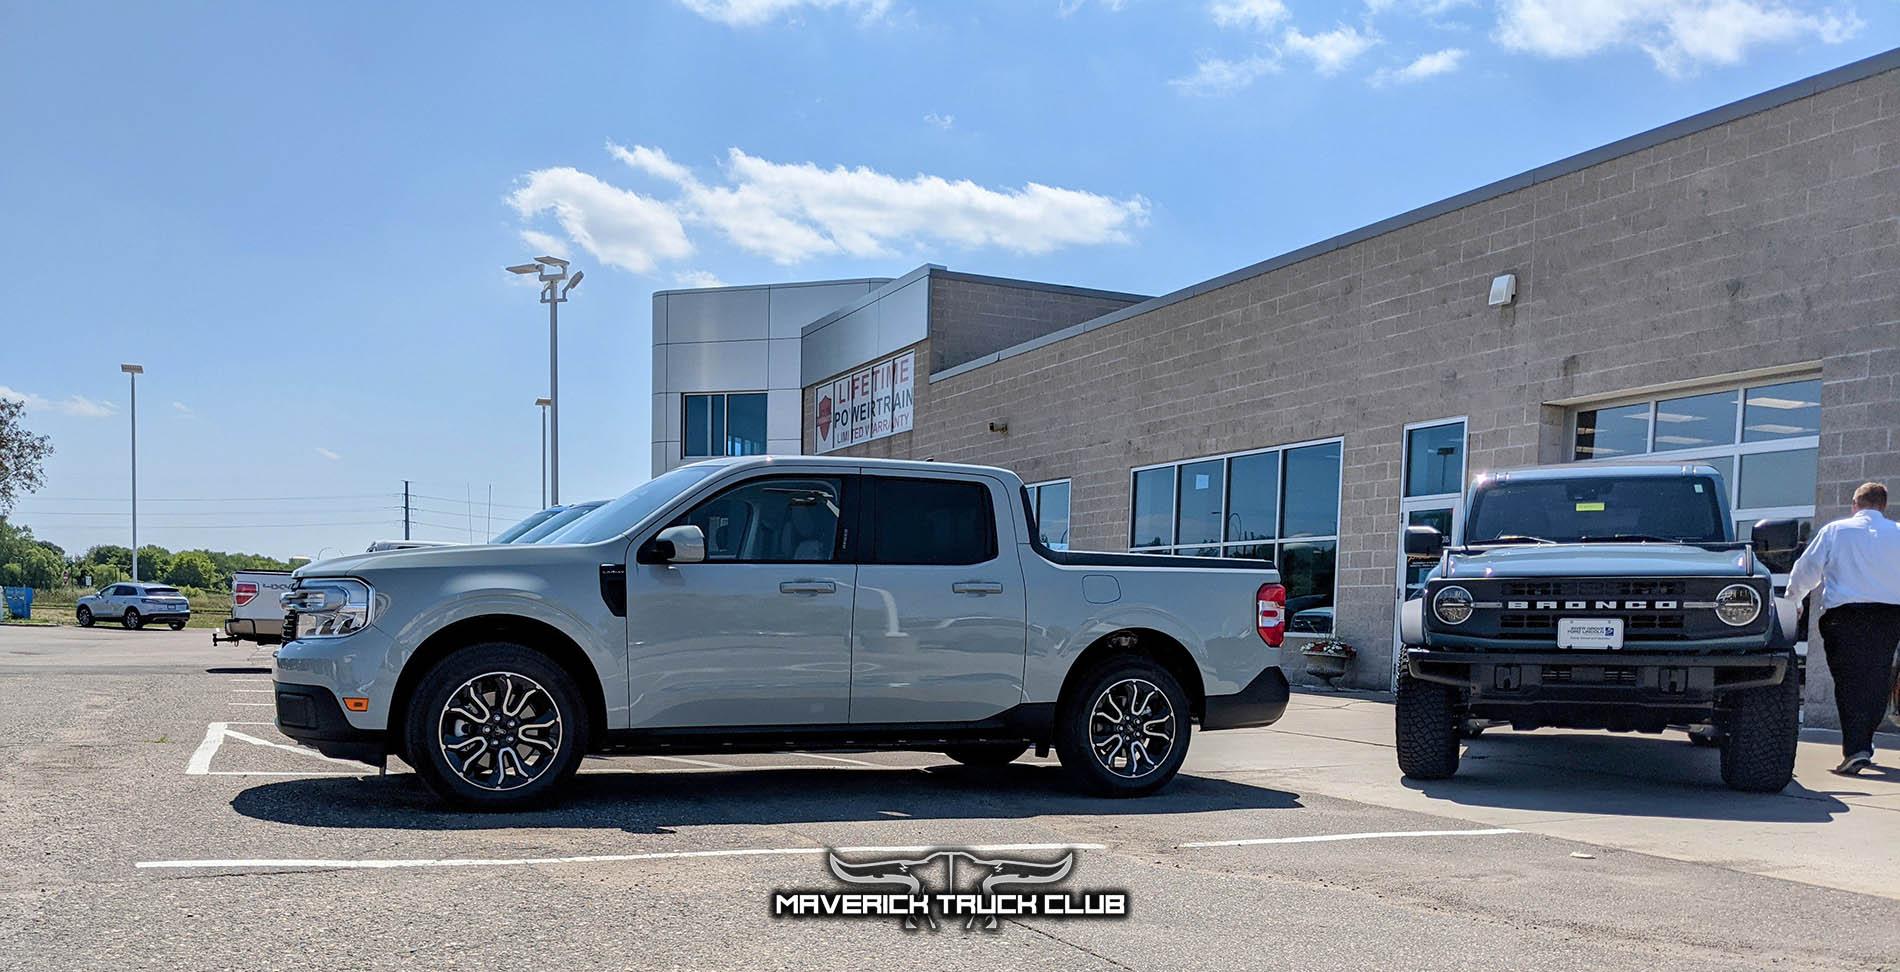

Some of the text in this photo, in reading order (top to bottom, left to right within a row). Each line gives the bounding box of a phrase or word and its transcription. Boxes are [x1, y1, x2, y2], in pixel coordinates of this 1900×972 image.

[839, 359, 909, 404] LIFETIME
[834, 388, 913, 428] POWERTRAIN
[837, 413, 910, 444] LIMITED WARRANTY
[1508, 601, 1677, 609] BRONCO
